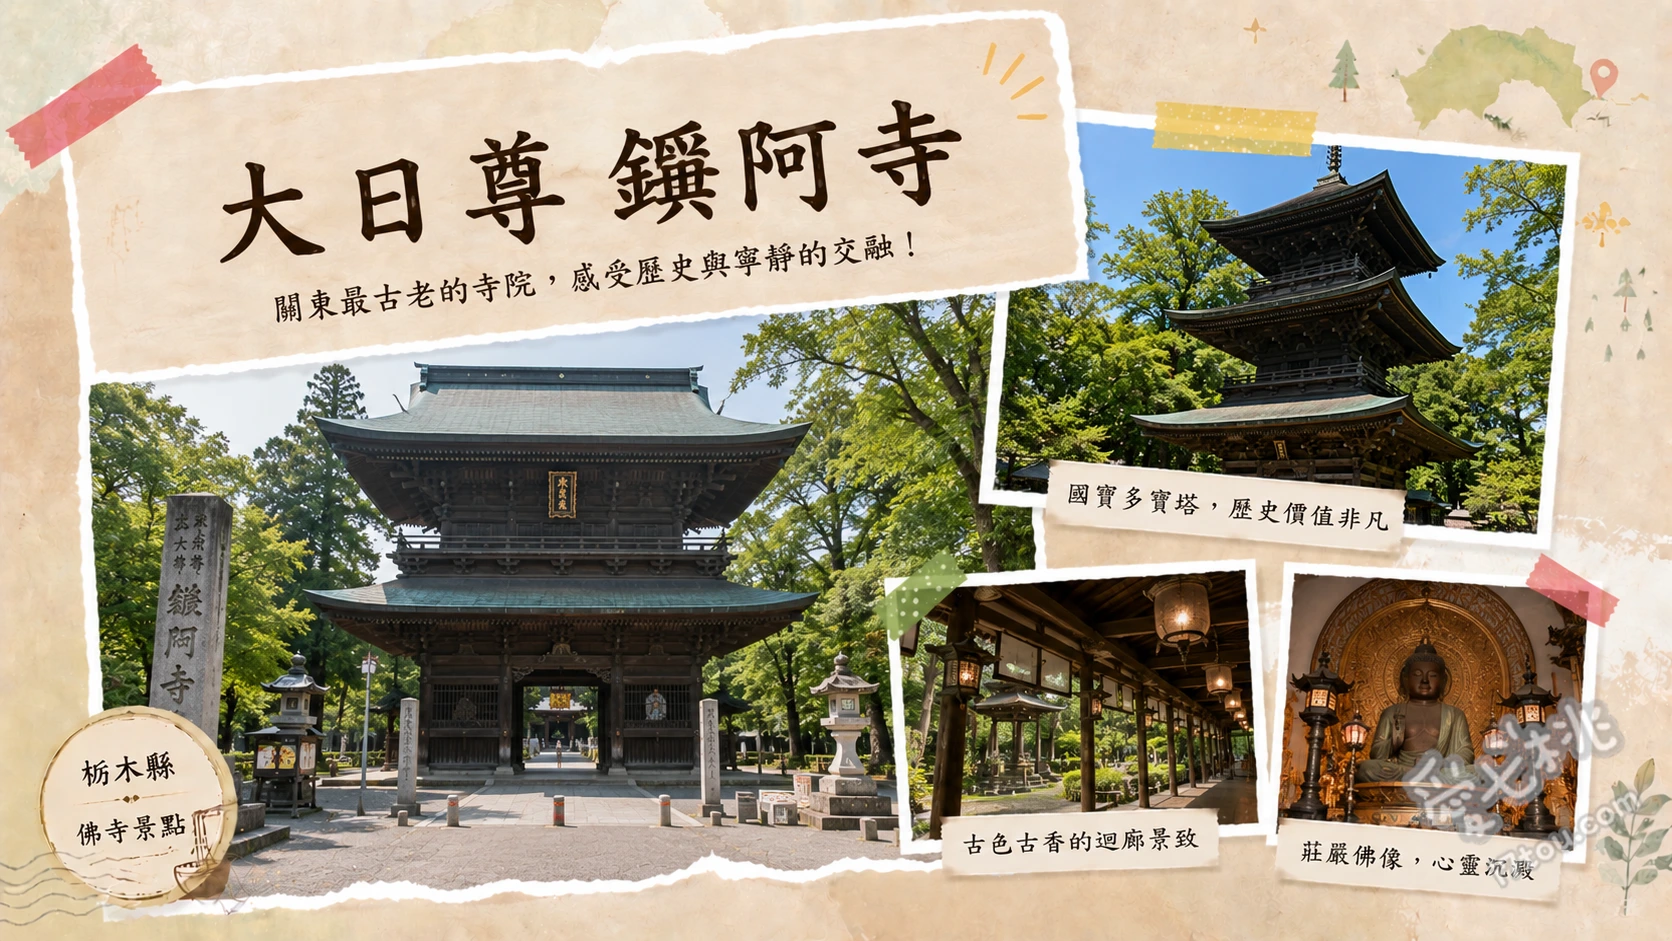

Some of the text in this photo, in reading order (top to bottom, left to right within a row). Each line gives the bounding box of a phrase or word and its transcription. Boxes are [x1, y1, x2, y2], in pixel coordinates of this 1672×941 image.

[219, 130, 566, 264] 大日尊
[274, 231, 915, 323] 關東最古老的寺院，感受歷史與寧靜的交融！
[1068, 482, 1390, 532] 國寶多寶塔，歷史價值非凡
[81, 751, 176, 788] 栃木縣
[76, 813, 186, 847] 佛寺景點
[963, 827, 1200, 856] 古色古香的迴廊景致
[1300, 840, 1535, 881] 莊嚴佛像，心靈沉澱
